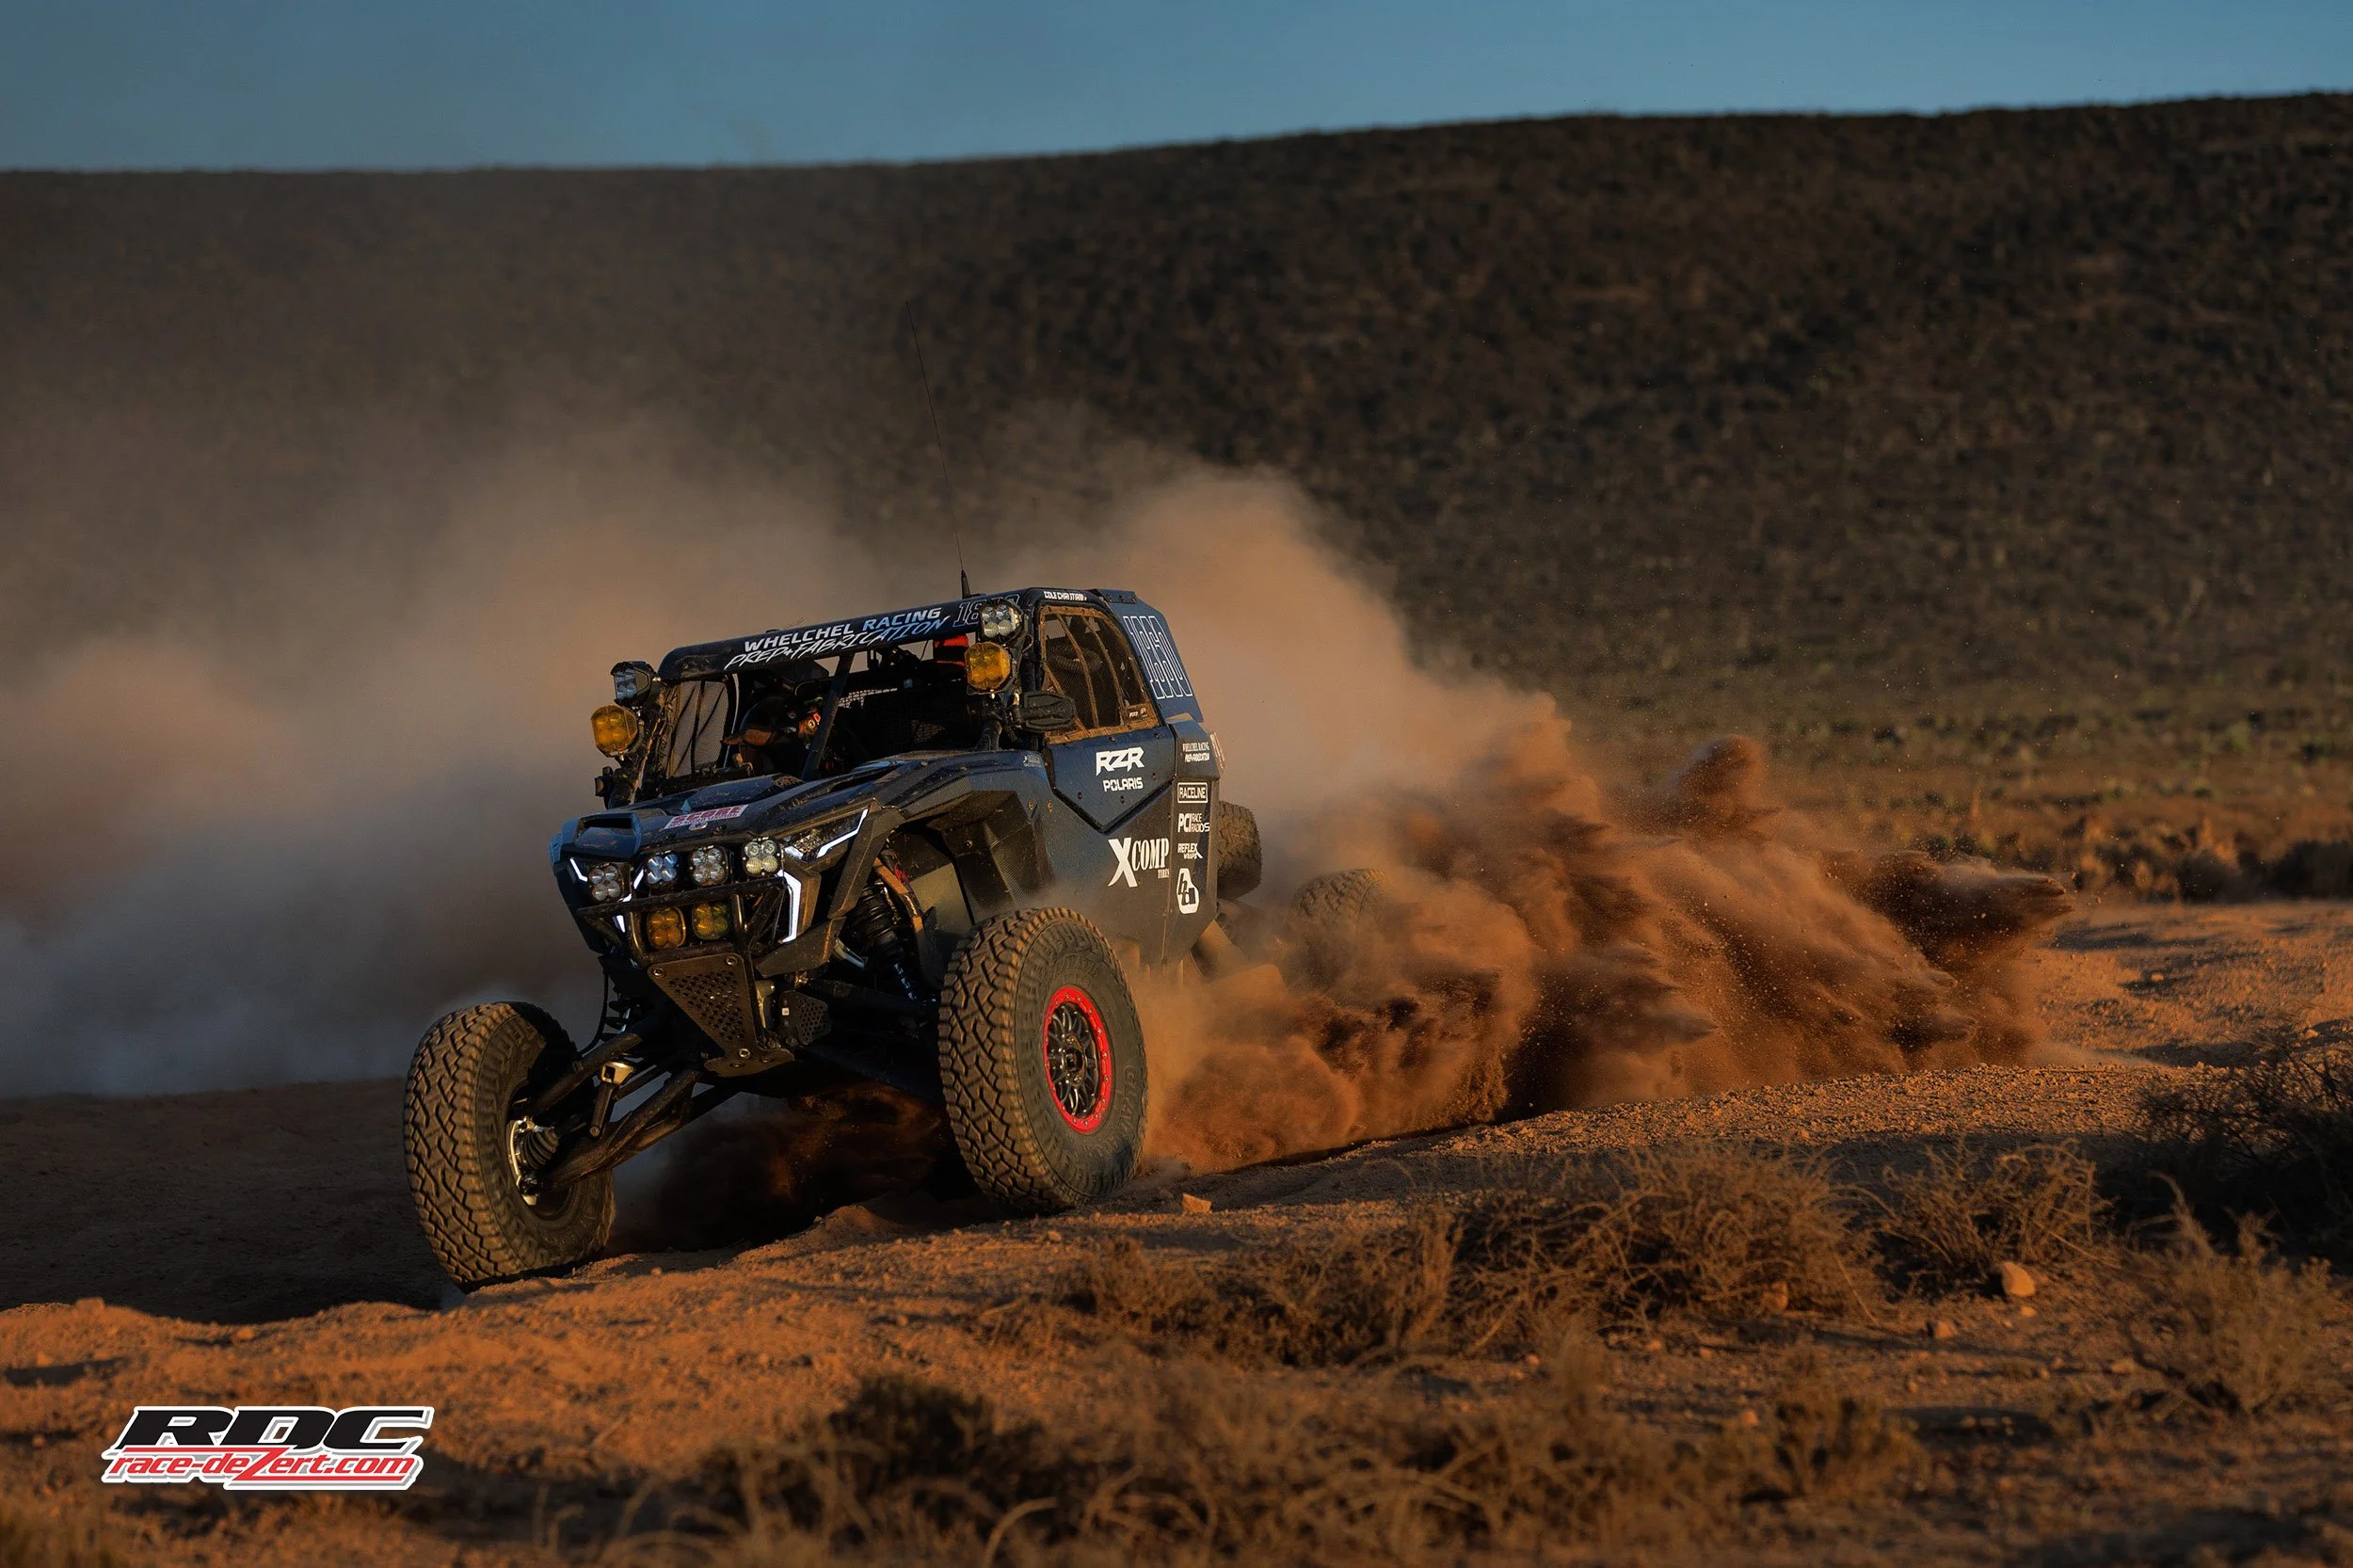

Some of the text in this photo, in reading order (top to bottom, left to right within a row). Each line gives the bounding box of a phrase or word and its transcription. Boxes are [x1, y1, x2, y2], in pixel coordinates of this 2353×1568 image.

[744, 607, 942, 652] WHELCHEL RACING
[1096, 746, 1145, 776] RZR
[1102, 776, 1144, 792] POLARIS
[1178, 787, 1207, 799] RACELINE
[1177, 812, 1193, 833] PCI
[1177, 842, 1202, 857] REFLEX
